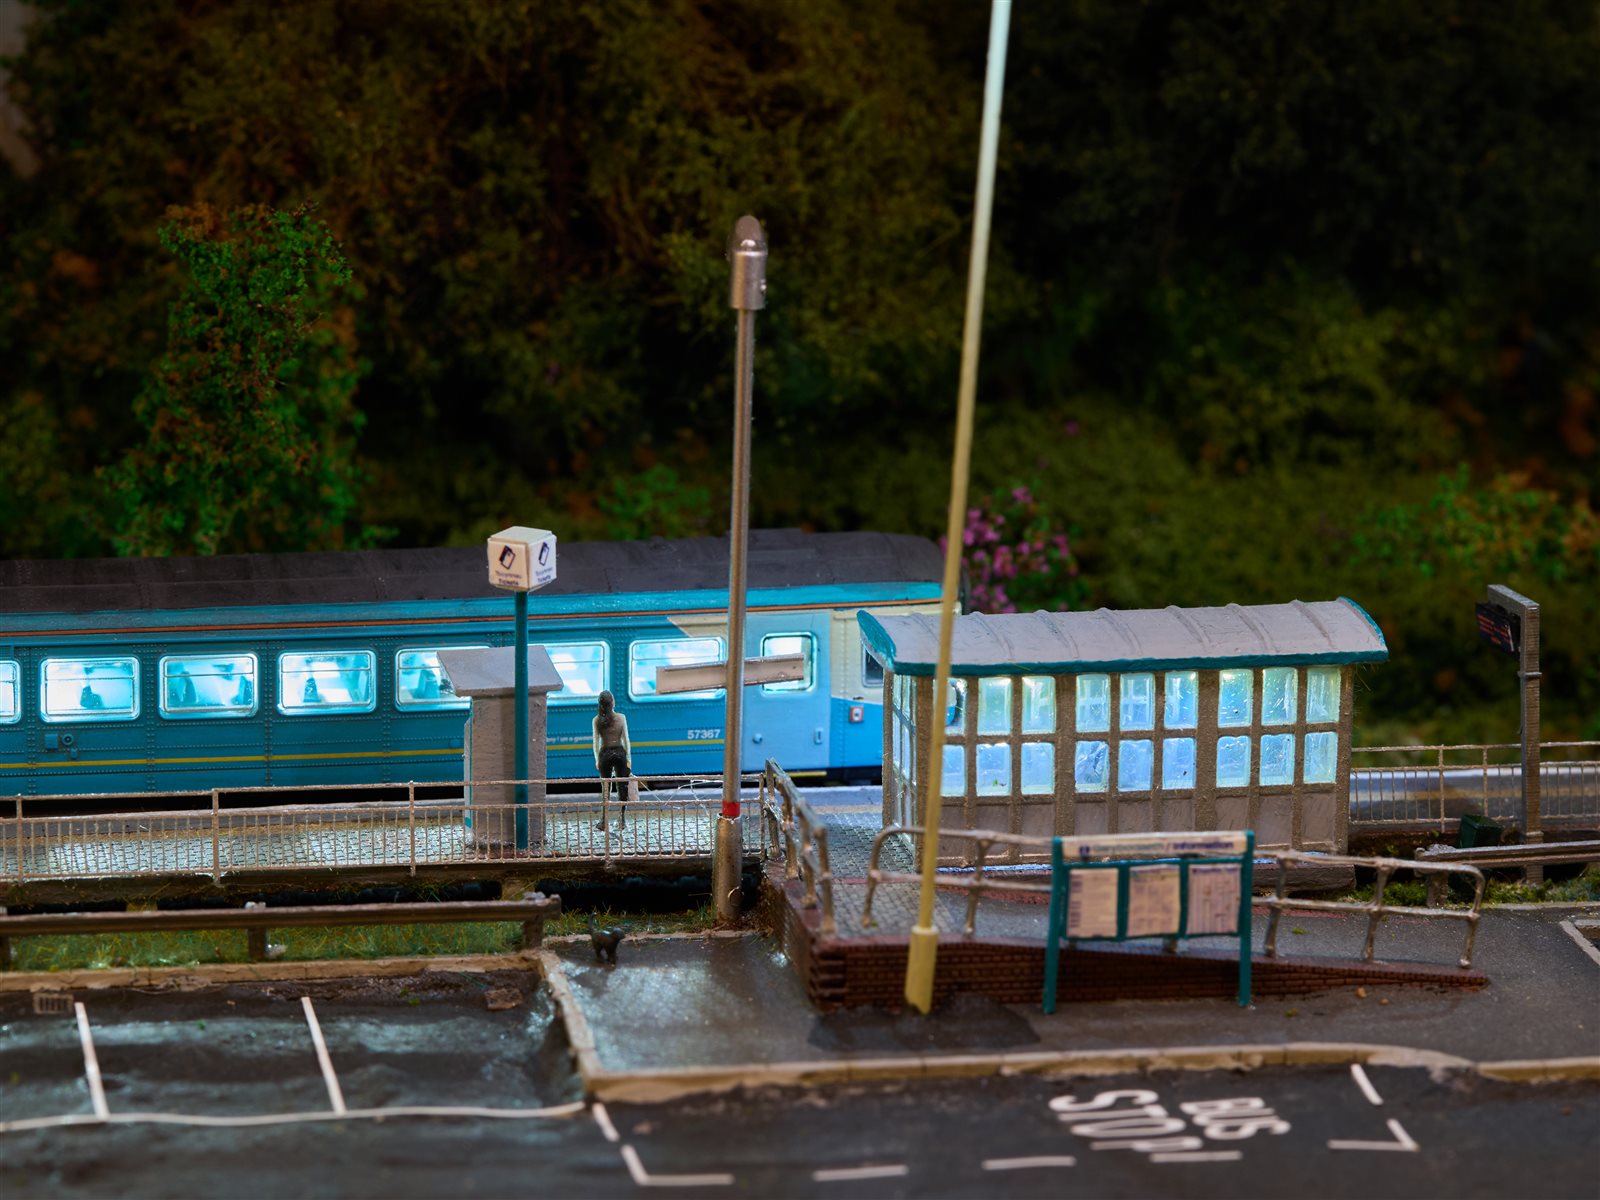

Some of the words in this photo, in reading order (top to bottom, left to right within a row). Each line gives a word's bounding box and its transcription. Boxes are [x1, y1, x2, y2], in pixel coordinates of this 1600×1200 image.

[687, 729, 720, 739] 57367
[1048, 1089, 1205, 1152] STOP
[1180, 1096, 1291, 1140] BUS
